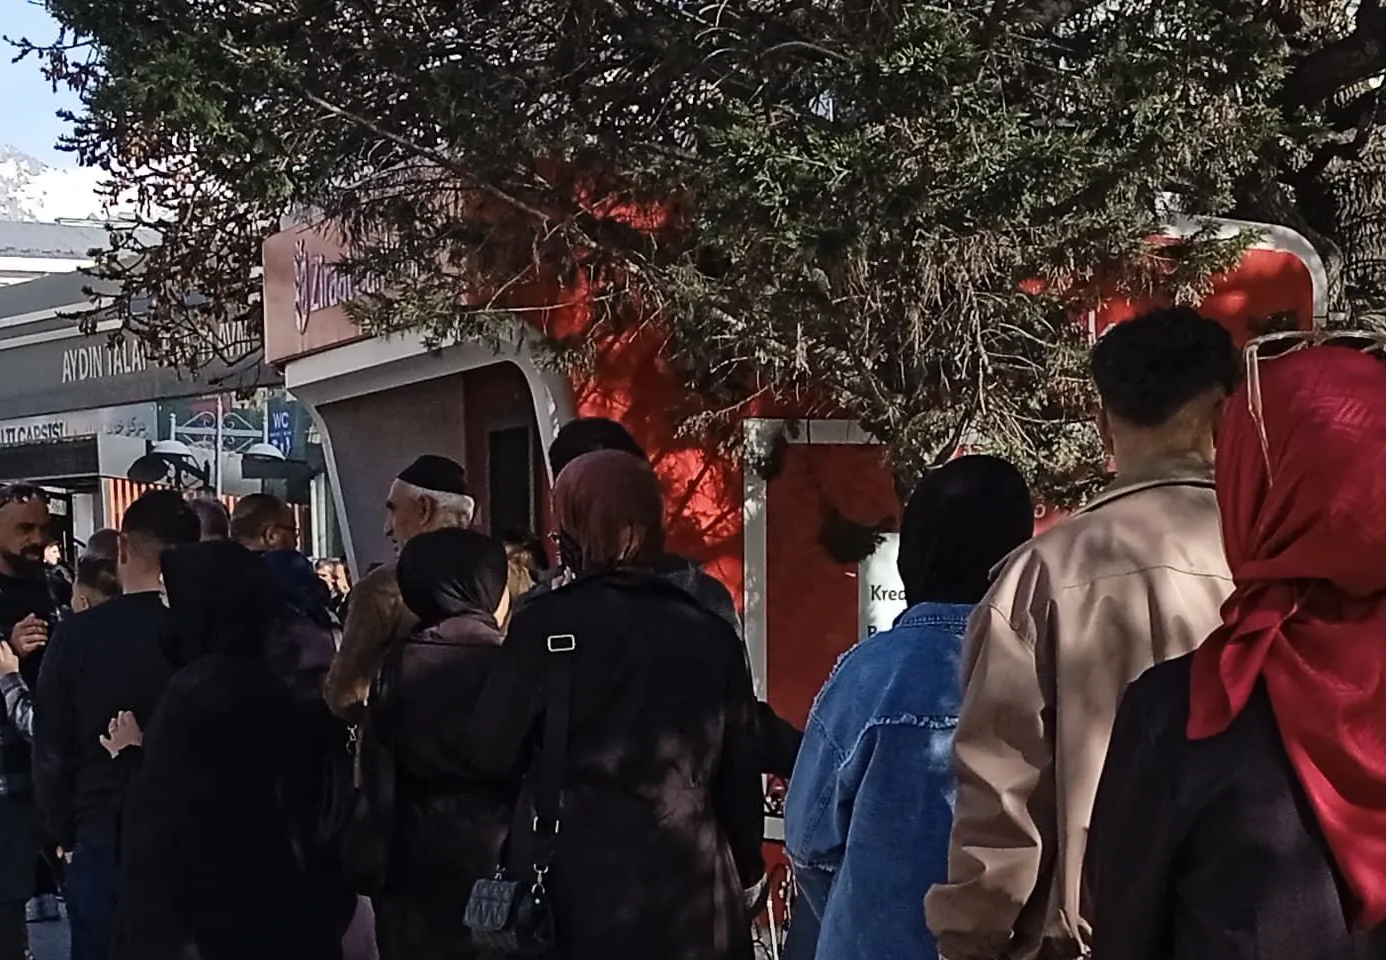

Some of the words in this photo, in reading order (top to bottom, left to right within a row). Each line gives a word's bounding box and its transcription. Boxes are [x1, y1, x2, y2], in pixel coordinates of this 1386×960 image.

[63, 344, 103, 383] AYDIN
[106, 339, 148, 376] TALA
[272, 411, 289, 428] WC
